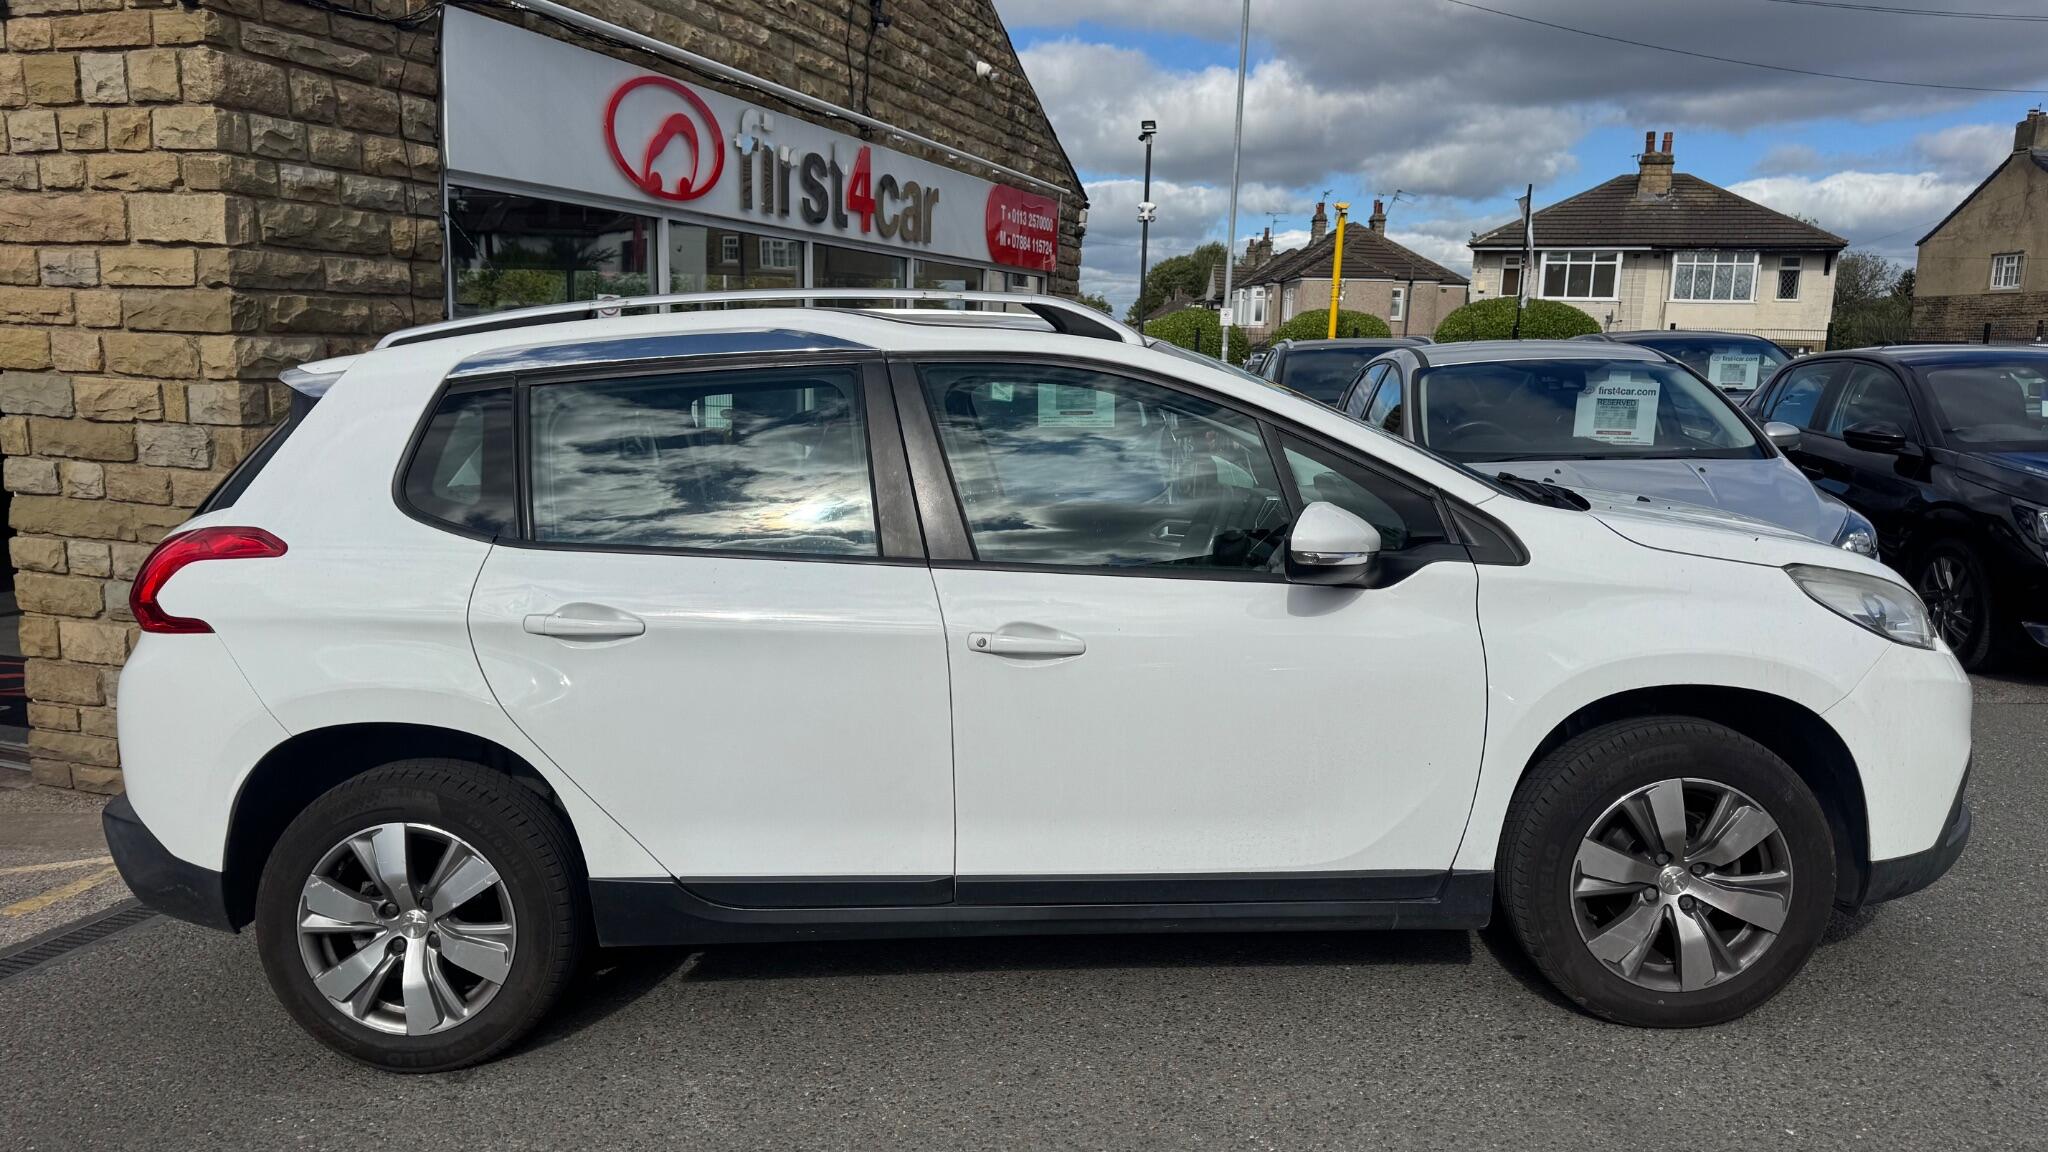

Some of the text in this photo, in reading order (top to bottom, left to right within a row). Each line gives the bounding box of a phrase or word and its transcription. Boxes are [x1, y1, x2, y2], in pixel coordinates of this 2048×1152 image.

[734, 108, 939, 244] first4car
[1001, 204, 1006, 220] T
[1011, 208, 1027, 226] 0113
[1000, 230, 1006, 246] M
[1032, 238, 1053, 256] 115724
[1598, 386, 1657, 396] first4car.com
